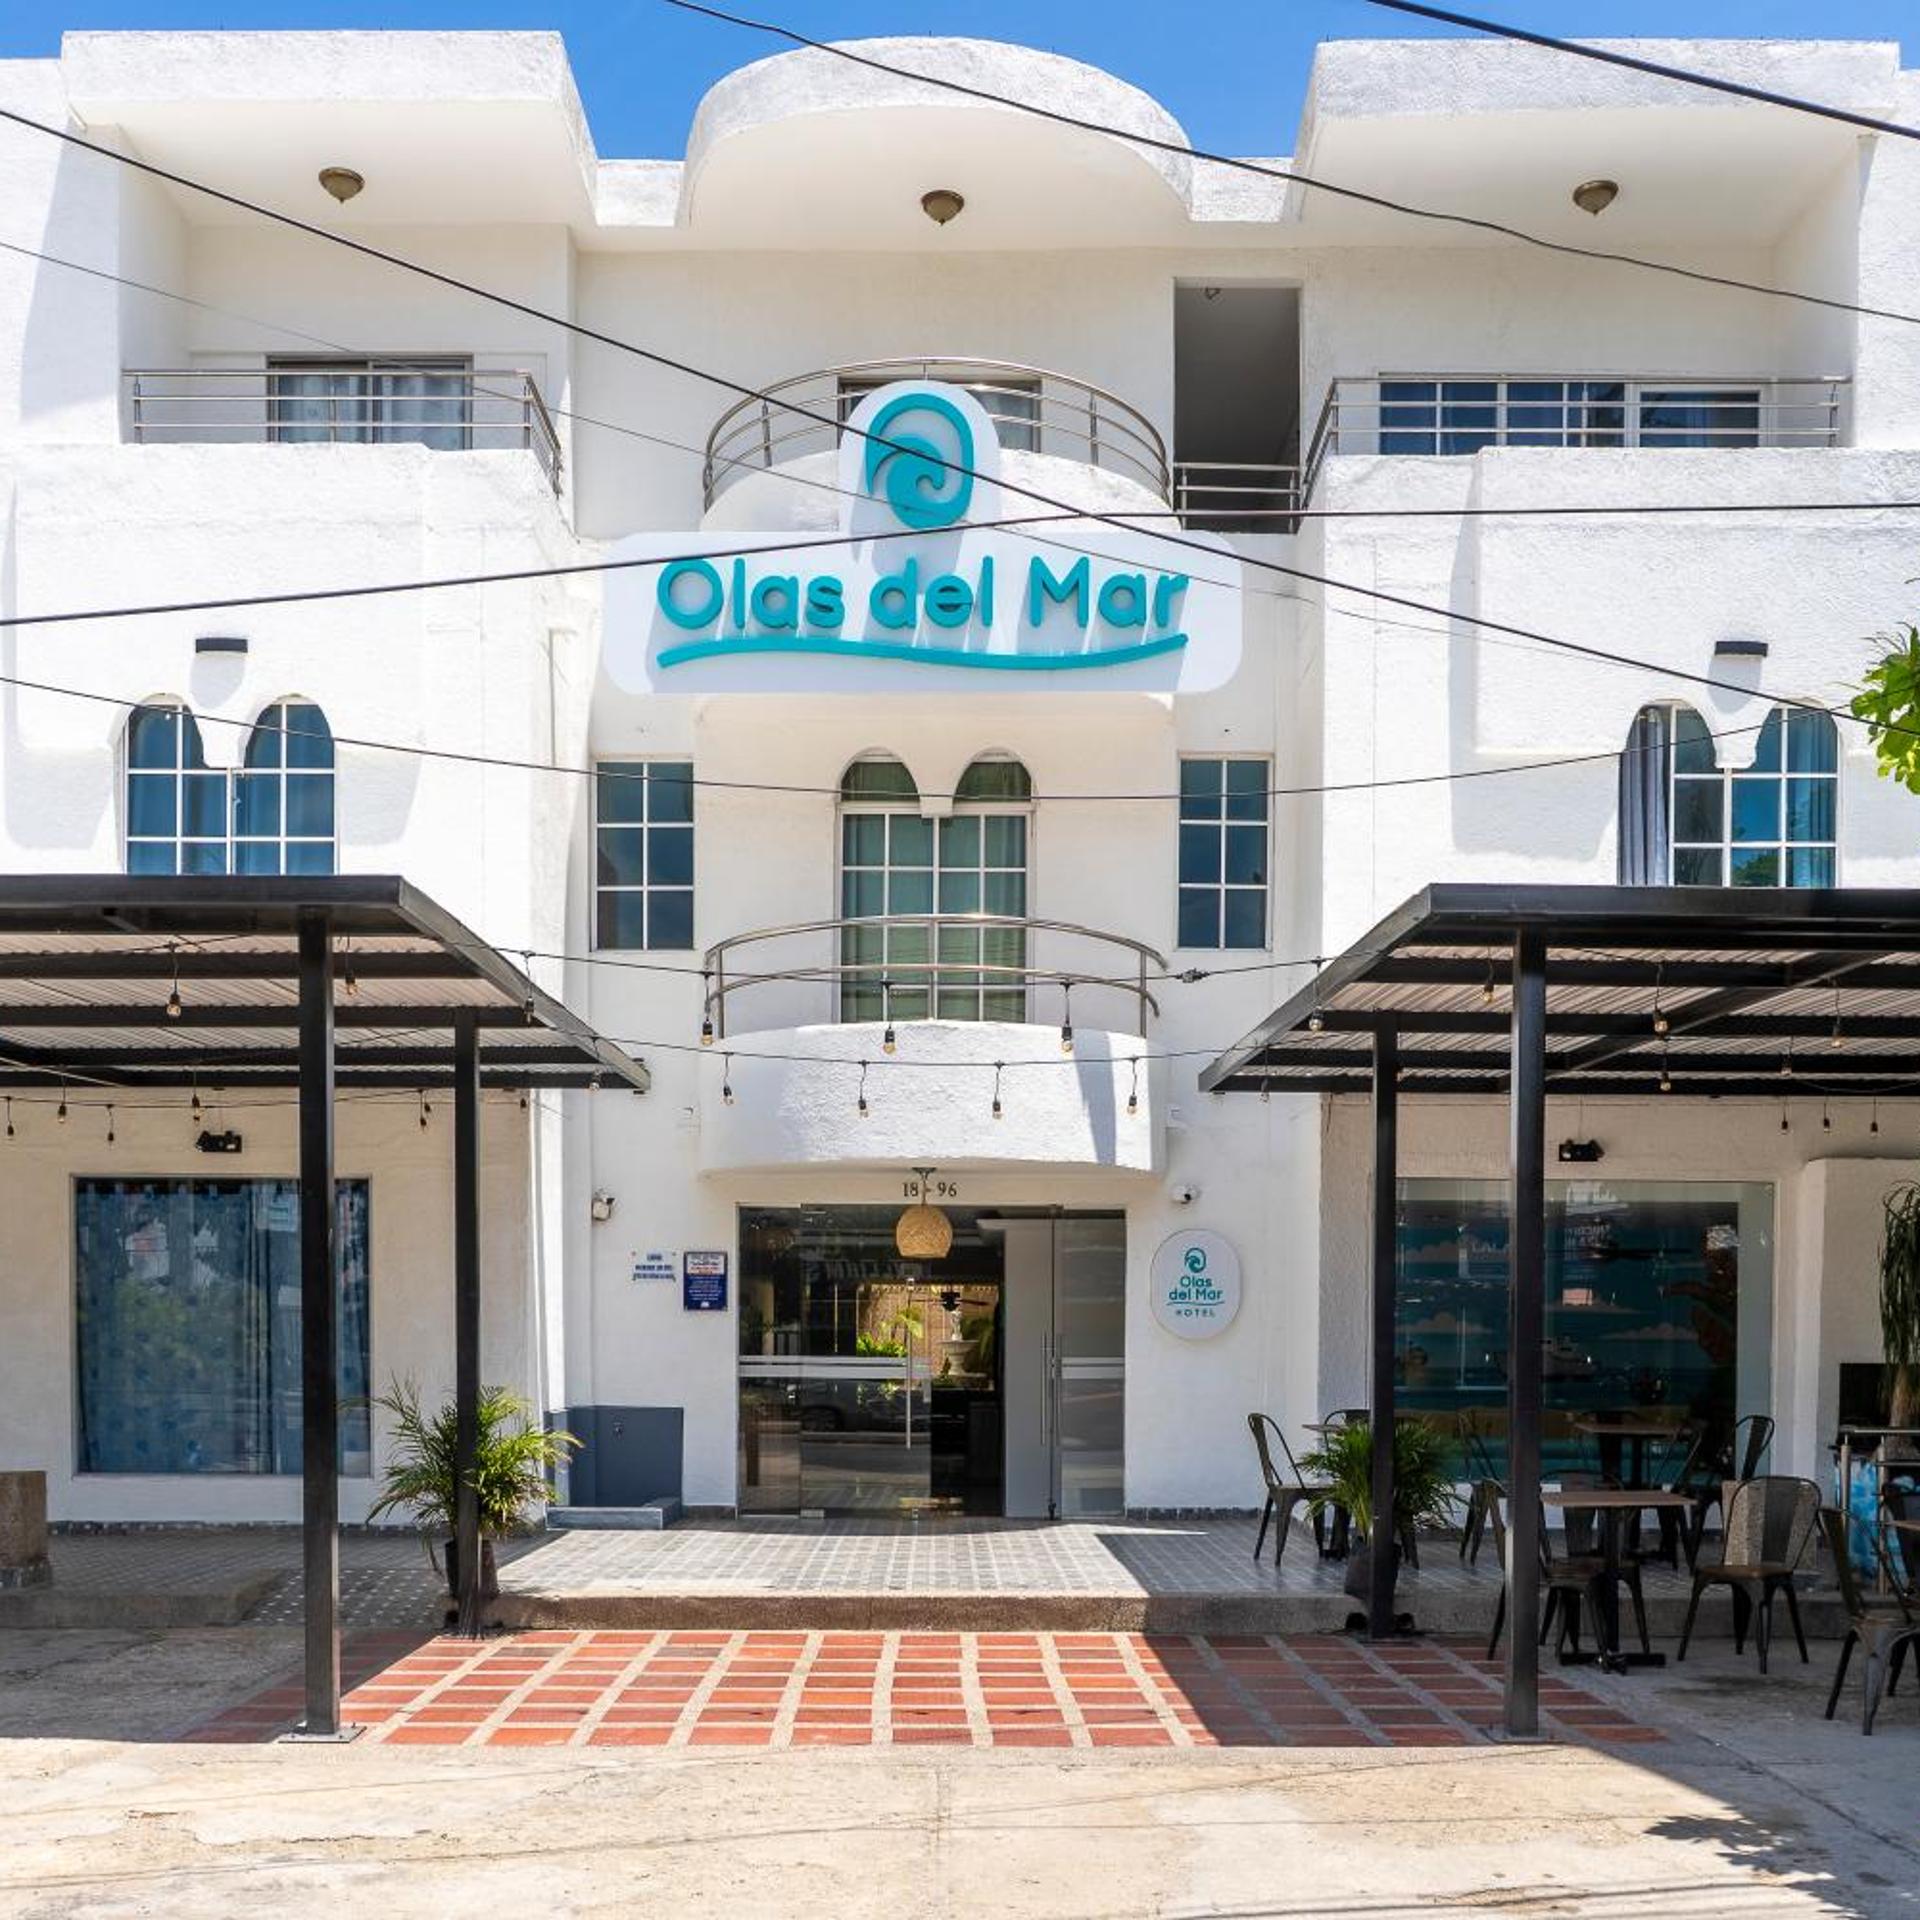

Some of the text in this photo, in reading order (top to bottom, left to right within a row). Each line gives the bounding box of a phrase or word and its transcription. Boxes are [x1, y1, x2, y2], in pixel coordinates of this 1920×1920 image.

[656, 555, 1190, 631] Olas del Mar
[902, 1182, 919, 1197] 18
[937, 1182, 958, 1197] 96
[1179, 1275, 1213, 1288] Olas
[1168, 1287, 1224, 1300] del Mar
[1175, 1309, 1217, 1318] HOTEL
